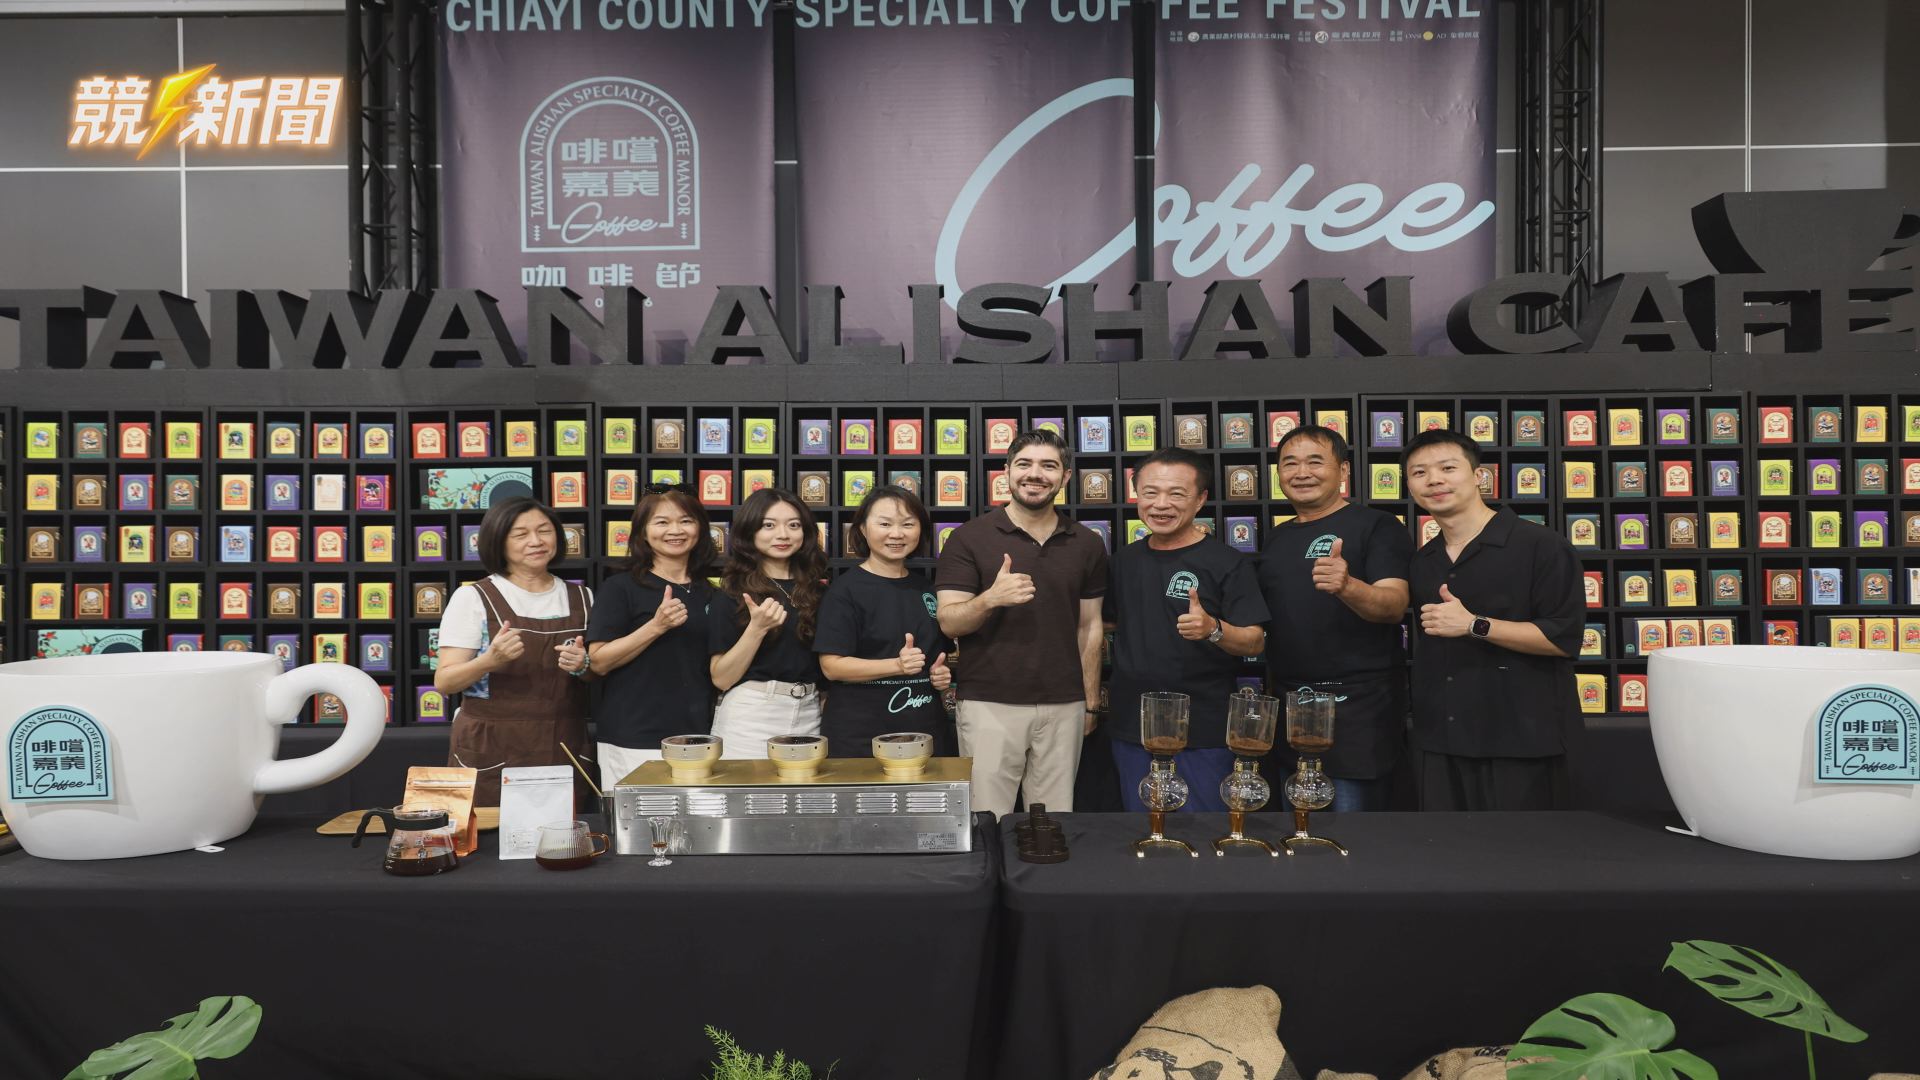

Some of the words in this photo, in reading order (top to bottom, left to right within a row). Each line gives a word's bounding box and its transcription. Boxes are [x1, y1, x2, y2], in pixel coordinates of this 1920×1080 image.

[446, 0, 582, 32] CHIAYI
[599, 0, 770, 31] COUNTY
[795, 0, 1025, 28] SPECIALTY
[573, 84, 660, 108] SPECIALTY
[531, 97, 573, 157] ALISHAN
[657, 105, 691, 156] COFFEE
[530, 160, 545, 218] TAIWAN
[562, 170, 659, 197] 嘉義
[676, 159, 691, 217] MANOR
[935, 77, 1496, 313] Coffee
[561, 202, 658, 244] Coffee
[521, 262, 701, 288] 咖啡節
[0, 286, 646, 369] TAIWAN
[695, 275, 1415, 366] ALISHAN
[1447, 271, 1920, 355] CAFE
[1850, 691, 1901, 705] SPECIALTY
[36, 712, 85, 725] SPECIALTY
[1825, 698, 1850, 730] ALISHAN
[1898, 703, 1918, 731] COFFEE
[15, 720, 36, 750] ALISHAN
[82, 722, 101, 751] COFFEE
[1824, 731, 1832, 761] TAIWAN
[1842, 737, 1900, 752] 嘉義
[1909, 733, 1918, 763] MANOR
[15, 751, 24, 781] TAIWAN
[32, 756, 86, 771] 嘉義
[94, 751, 103, 780] MANOR
[1841, 753, 1898, 776] Coffee
[33, 772, 86, 795] Coffee
